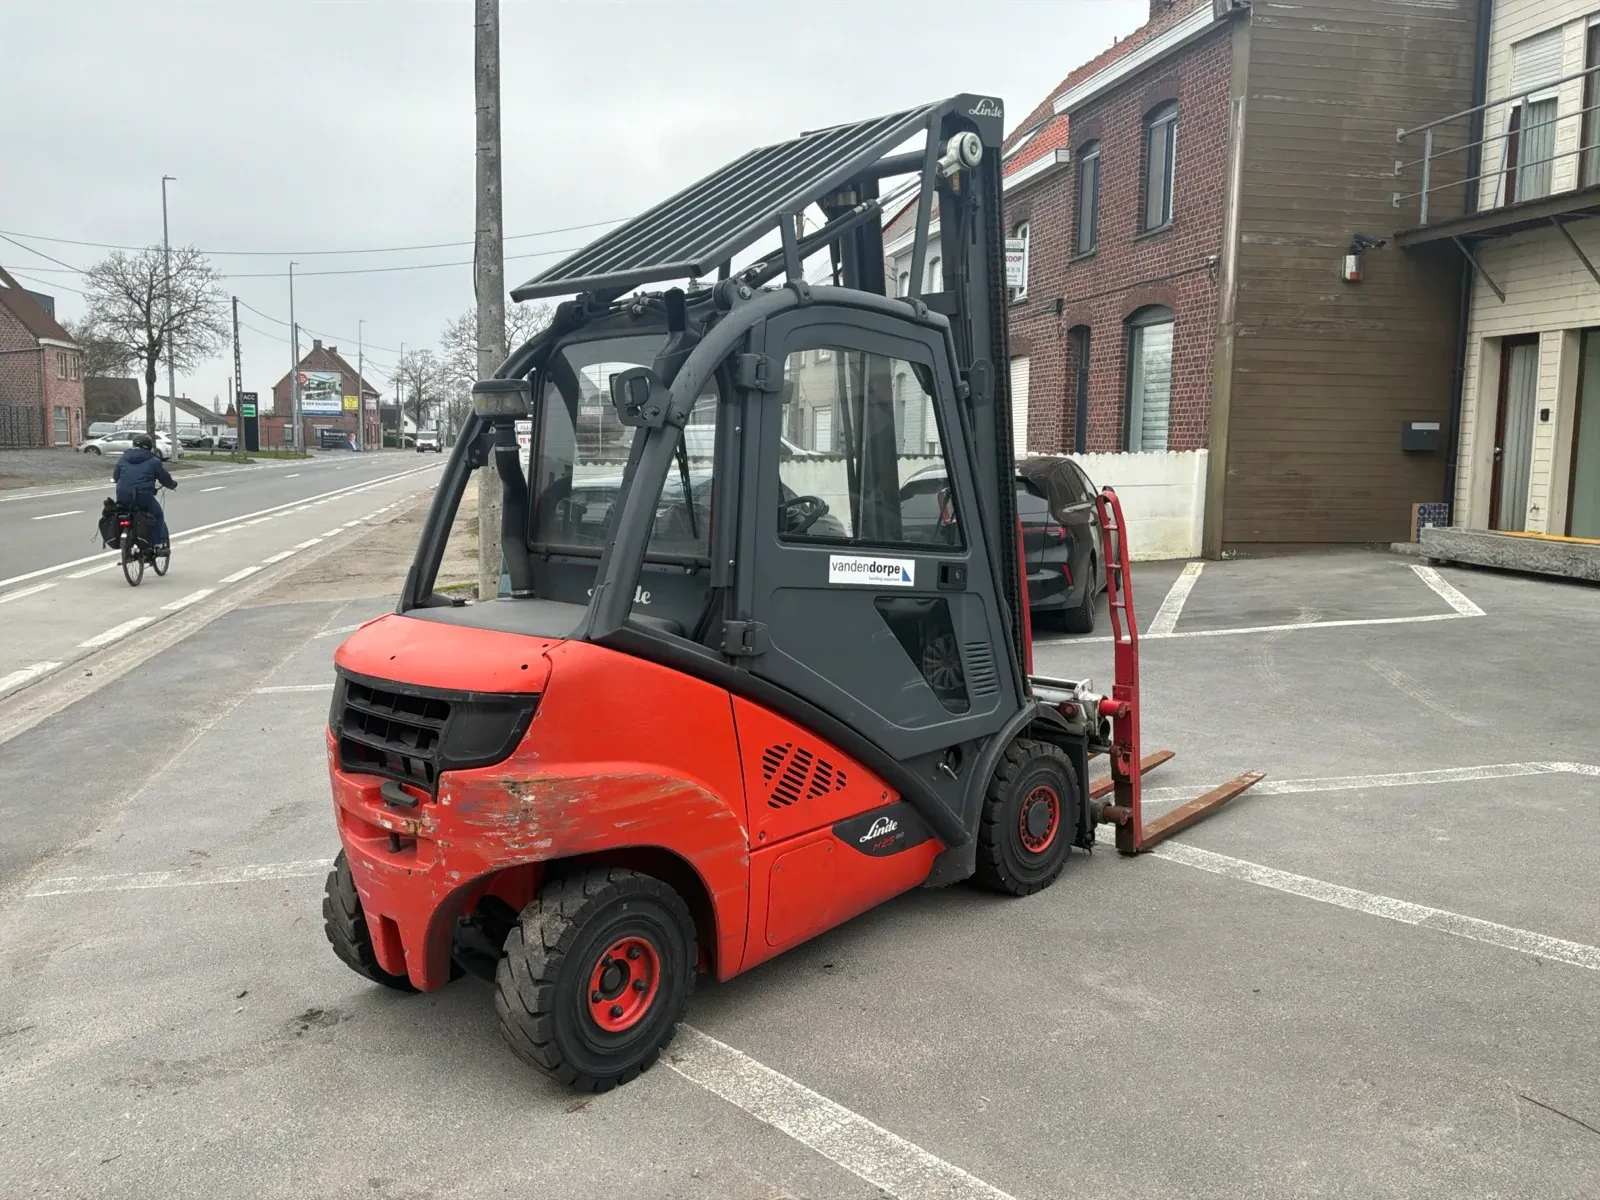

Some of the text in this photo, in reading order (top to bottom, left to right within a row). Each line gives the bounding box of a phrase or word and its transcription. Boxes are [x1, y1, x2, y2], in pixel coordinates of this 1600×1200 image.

[968, 98, 1003, 118] Linde
[832, 560, 900, 576] vandendorpe
[860, 816, 897, 842] Linde
